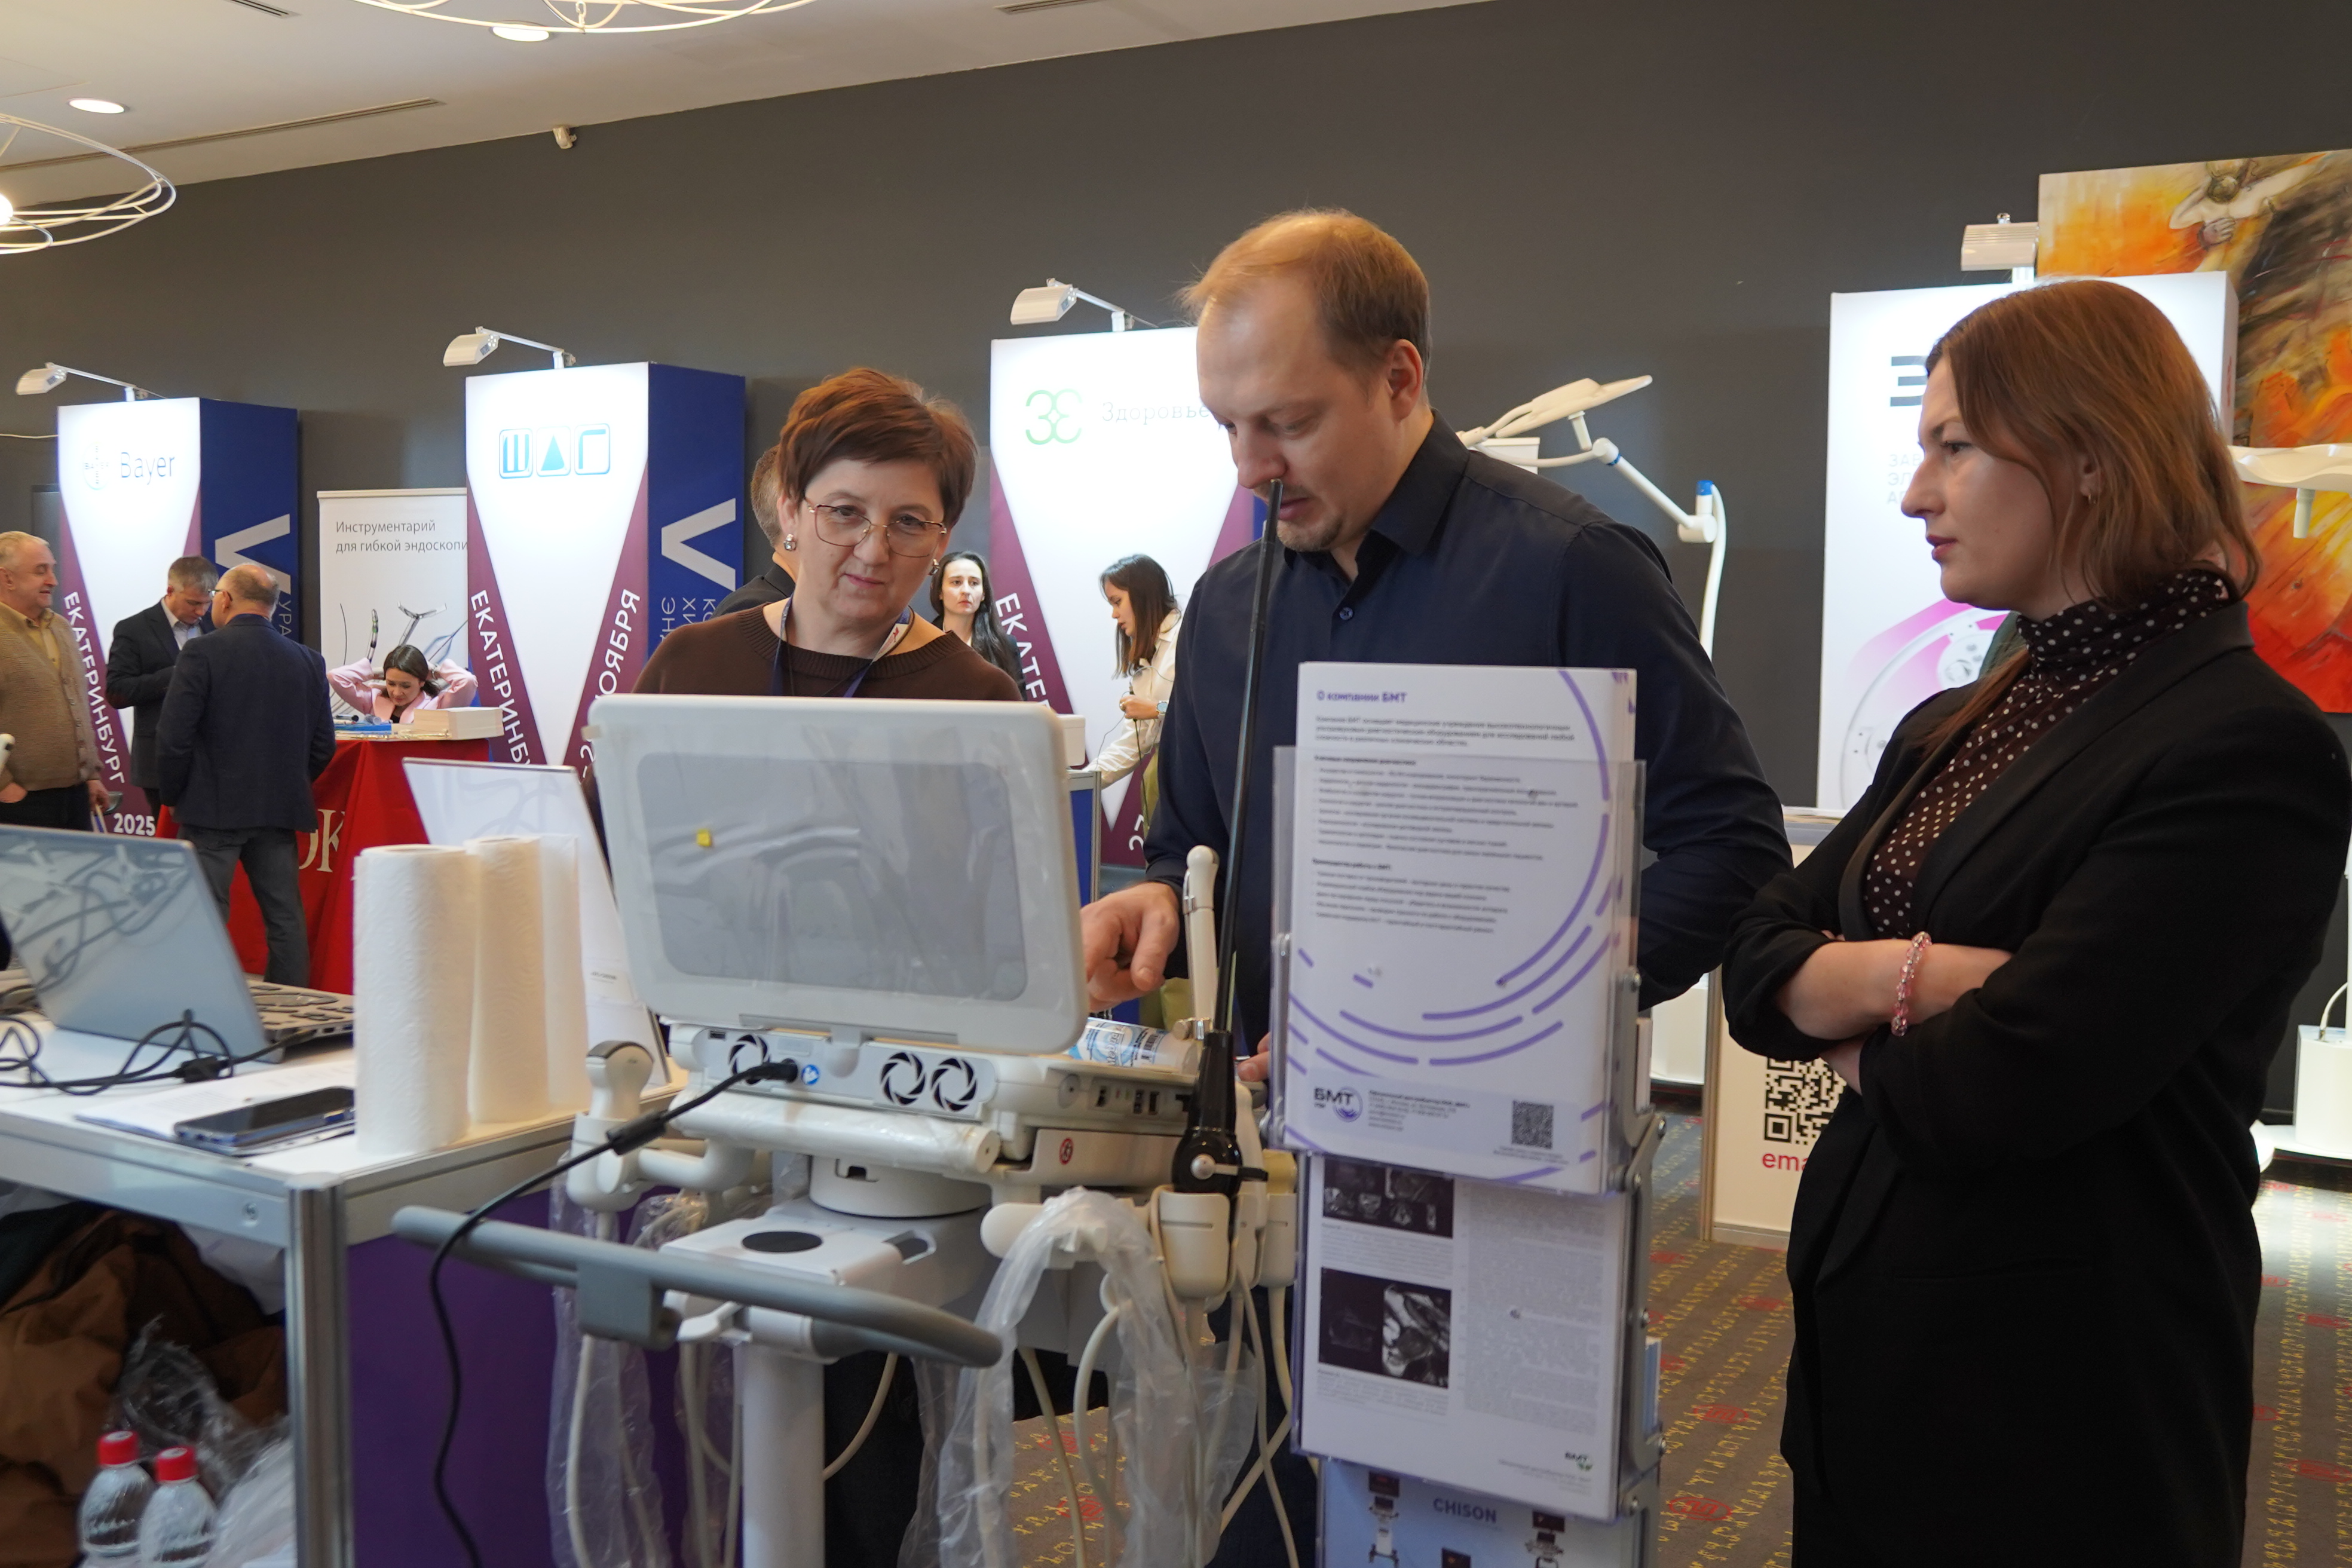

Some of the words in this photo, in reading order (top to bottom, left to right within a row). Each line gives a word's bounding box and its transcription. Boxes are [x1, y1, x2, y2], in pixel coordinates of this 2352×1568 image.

[1102, 401, 1211, 425] Здоровье
[121, 451, 176, 486] Bayer
[336, 519, 436, 535] Инструментарий
[336, 542, 357, 555] для
[360, 539, 401, 552] гибкой
[405, 541, 468, 553] эндоскопи
[595, 589, 641, 699] ОЯБРЯ
[995, 592, 1051, 710] ЕКАТЕ
[64, 591, 125, 784] ЕКАТЕРИНБУРГ
[471, 589, 531, 765] ЕКАТЕРИНБ
[113, 812, 156, 837] 2025
[1434, 1497, 1497, 1524] CHISON
